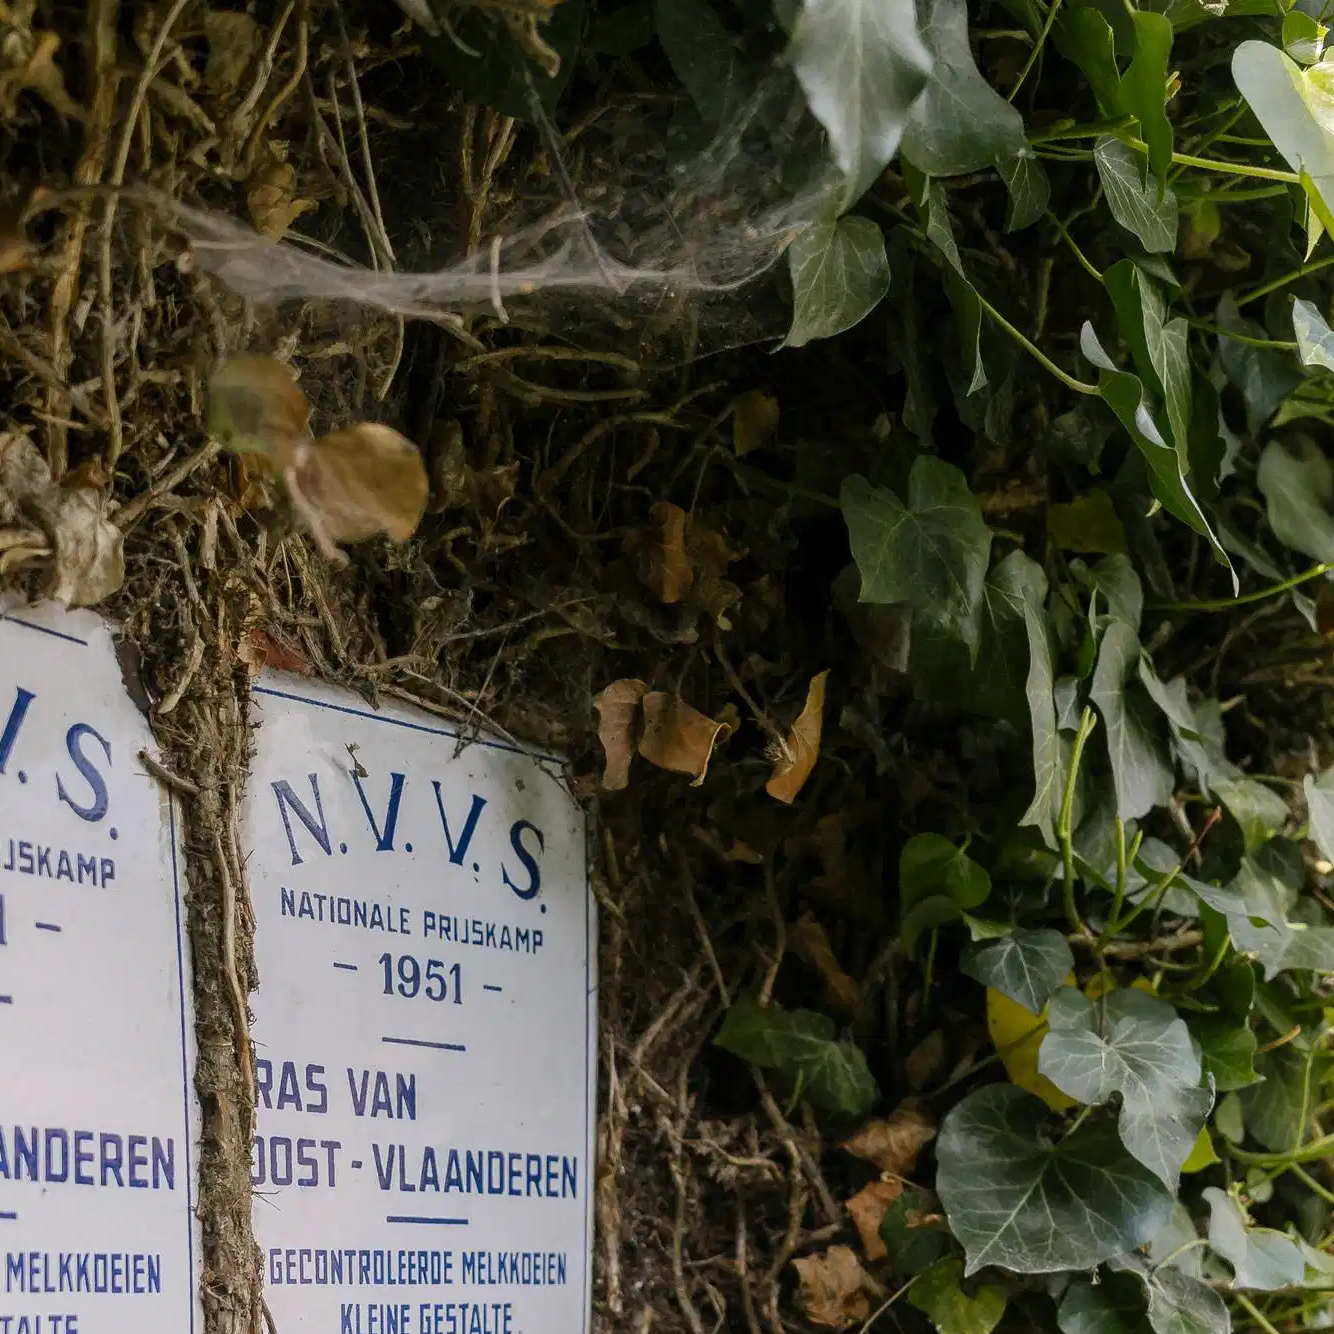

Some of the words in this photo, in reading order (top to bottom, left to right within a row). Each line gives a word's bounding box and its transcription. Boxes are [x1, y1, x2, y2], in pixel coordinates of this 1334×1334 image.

[281, 888, 410, 934] NATIONALE
[424, 911, 544, 955] PRIJSKAMP
[379, 953, 462, 1004] 1951
[255, 1059, 328, 1114] RAS
[347, 1068, 416, 1120] VAN
[7, 1252, 160, 1293] MELKKOEIEN
[270, 1249, 452, 1284] GECONTROLEERDE
[463, 1252, 566, 1284] MELKKOEIEN
